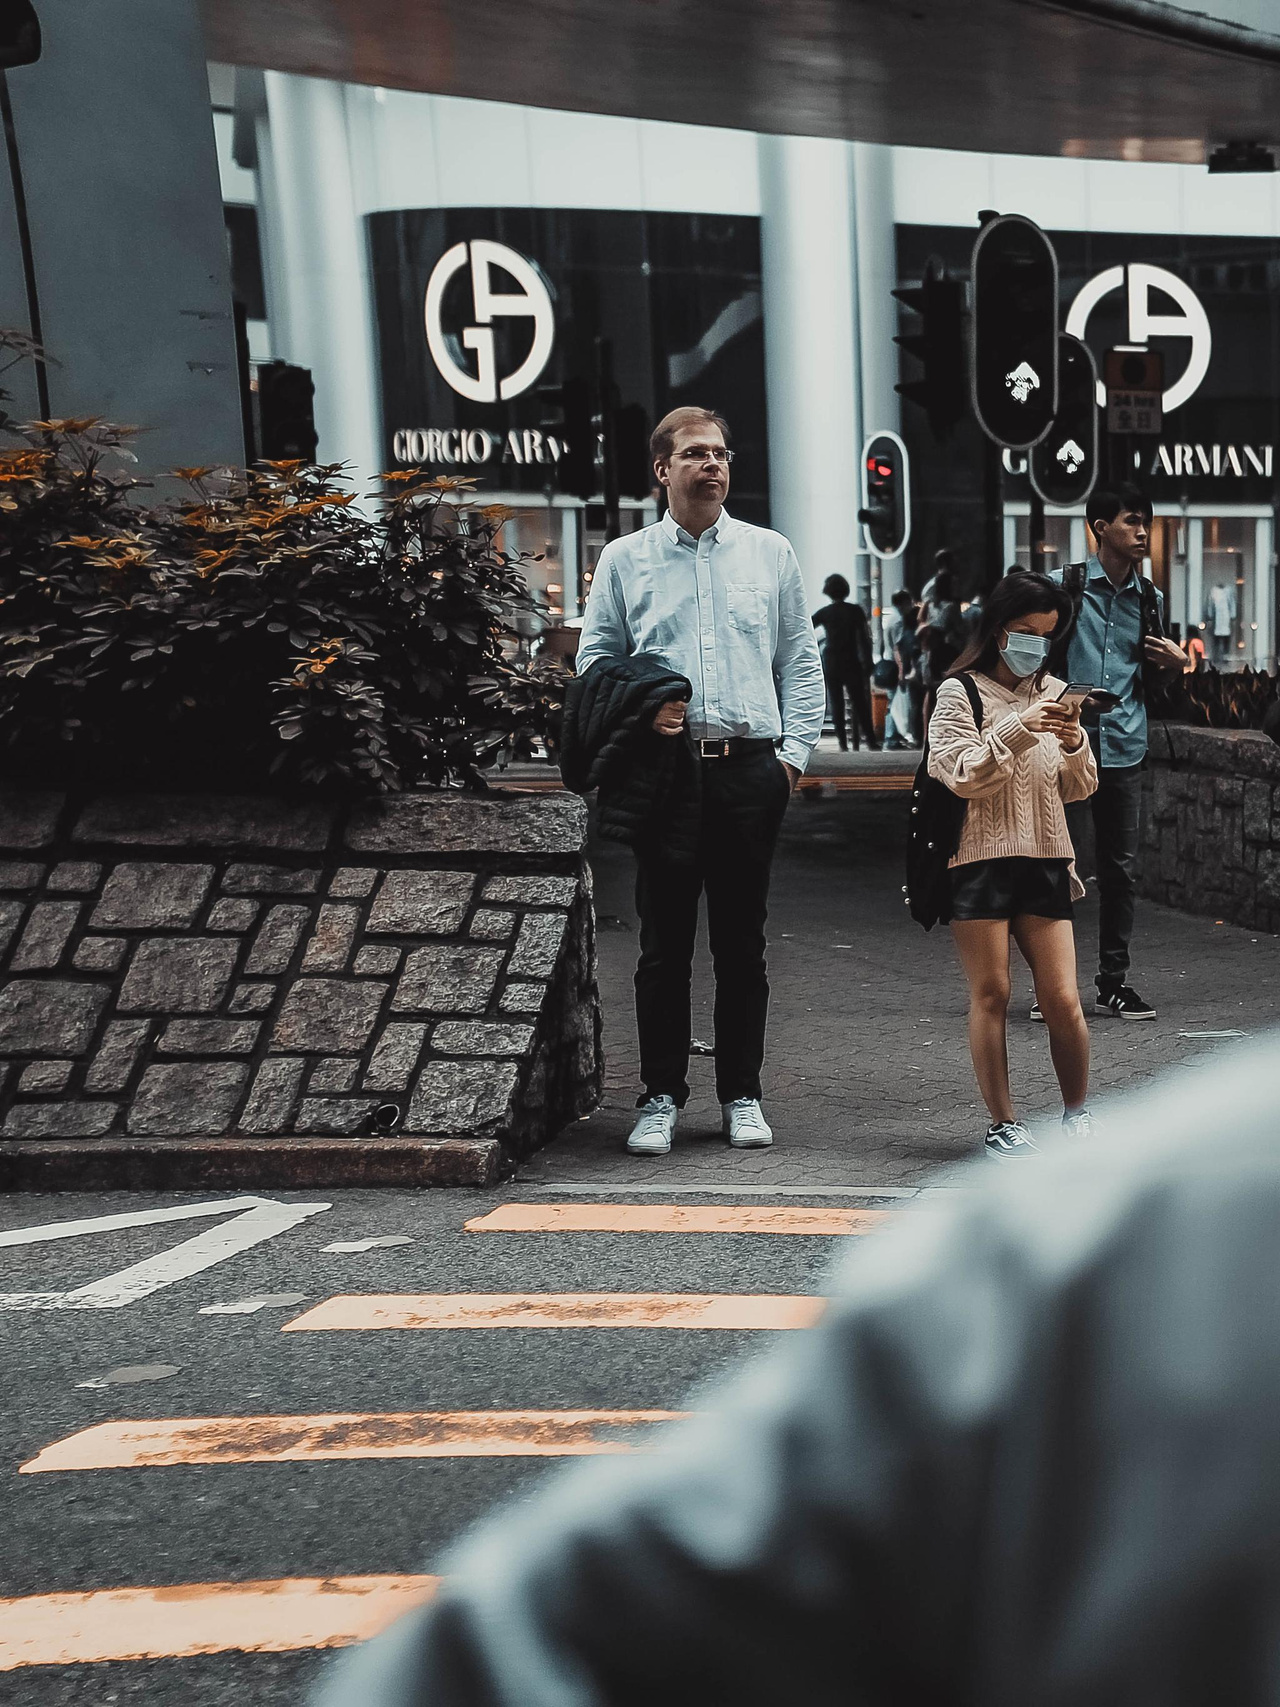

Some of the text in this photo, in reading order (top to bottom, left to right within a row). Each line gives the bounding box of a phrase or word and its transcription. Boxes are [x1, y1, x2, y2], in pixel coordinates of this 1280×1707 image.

[424, 239, 555, 403] GA
[393, 428, 492, 464] GIORGIO
[1150, 444, 1273, 477] ARMANI
